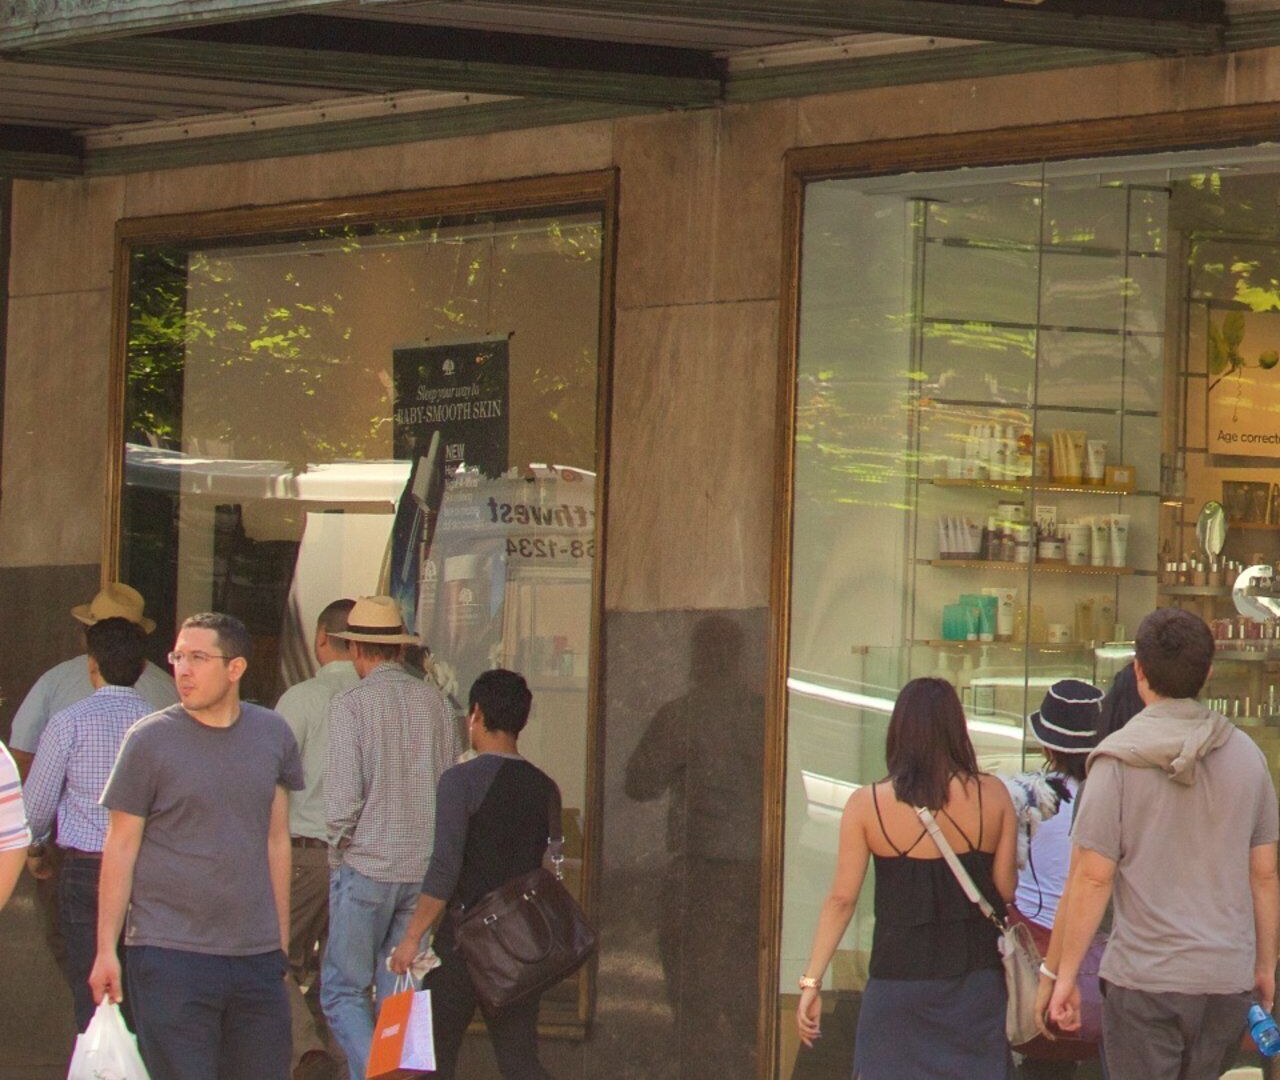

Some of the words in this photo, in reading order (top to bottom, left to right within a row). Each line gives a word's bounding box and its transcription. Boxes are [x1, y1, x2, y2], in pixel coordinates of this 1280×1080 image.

[473, 399, 501, 419] SKIN
[1217, 429, 1239, 444] Age
[446, 443, 465, 460] NEW
